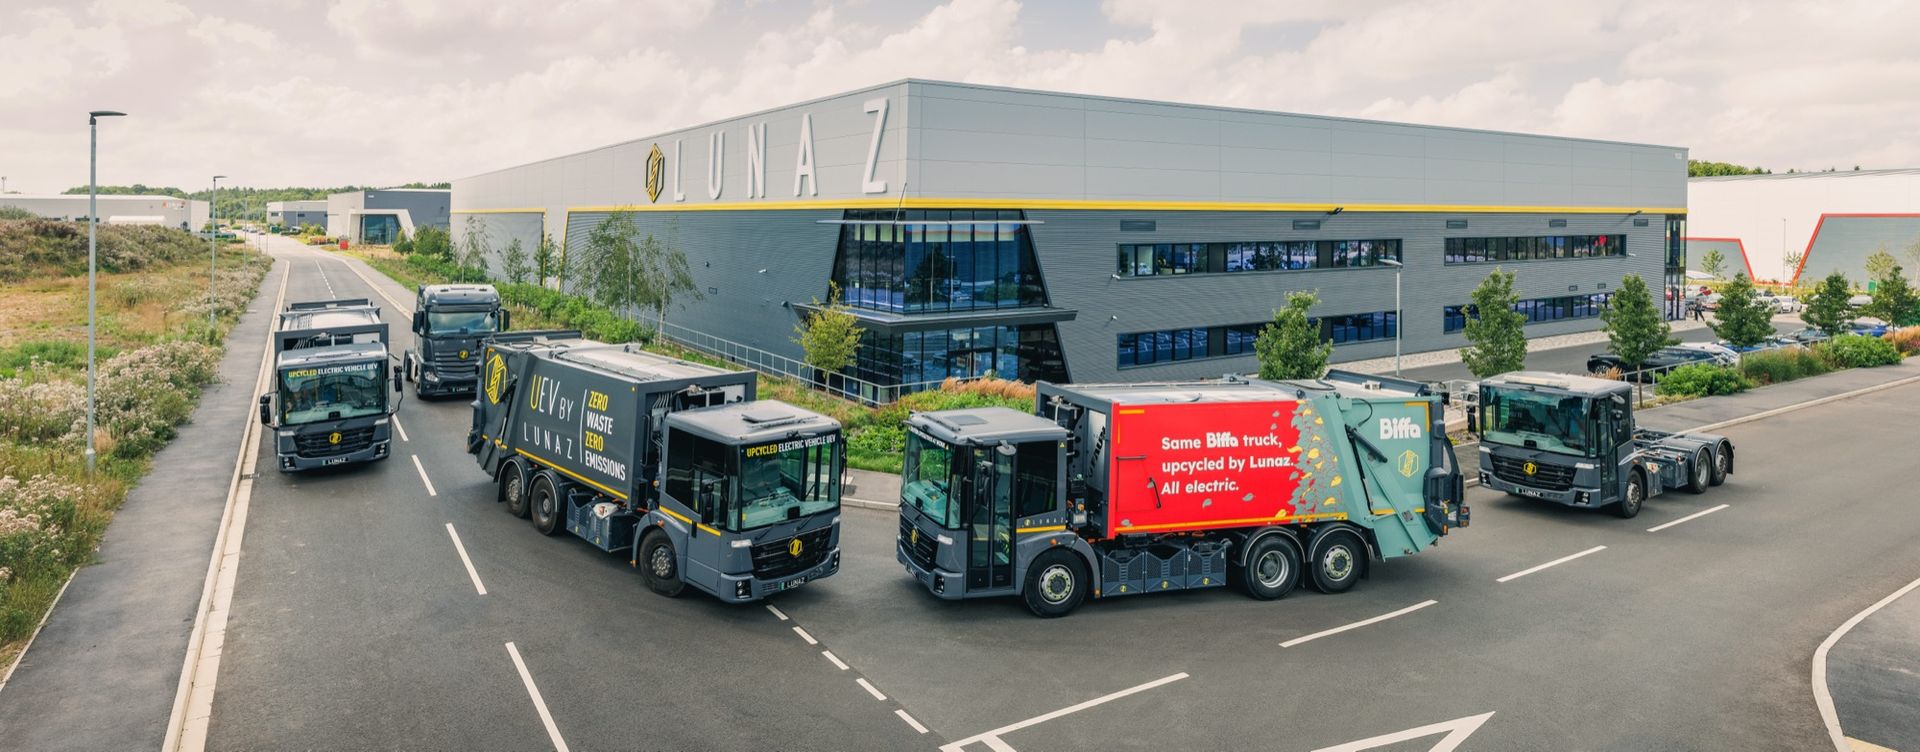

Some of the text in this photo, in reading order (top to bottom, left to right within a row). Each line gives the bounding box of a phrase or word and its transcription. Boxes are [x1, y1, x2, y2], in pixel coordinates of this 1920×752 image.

[674, 97, 889, 202] LUNAZ
[288, 362, 378, 378] UPCYCLED ELECTRIC VEHICLE UEV
[530, 374, 574, 422] UEV BY
[588, 390, 609, 412] ZERO
[586, 411, 614, 435] WASTE
[1379, 416, 1421, 440] Biffa
[524, 421, 573, 460] LUNAZ
[585, 430, 604, 452] ZERO
[746, 434, 836, 457] UPCYCLED ELECTRIC VEHICLE UEV
[1161, 431, 1282, 450] Same Biffa truck,
[585, 450, 626, 481] EMISSIONS
[1162, 455, 1294, 475] upcycled by Lunaz.
[1161, 477, 1239, 495] All electric.
